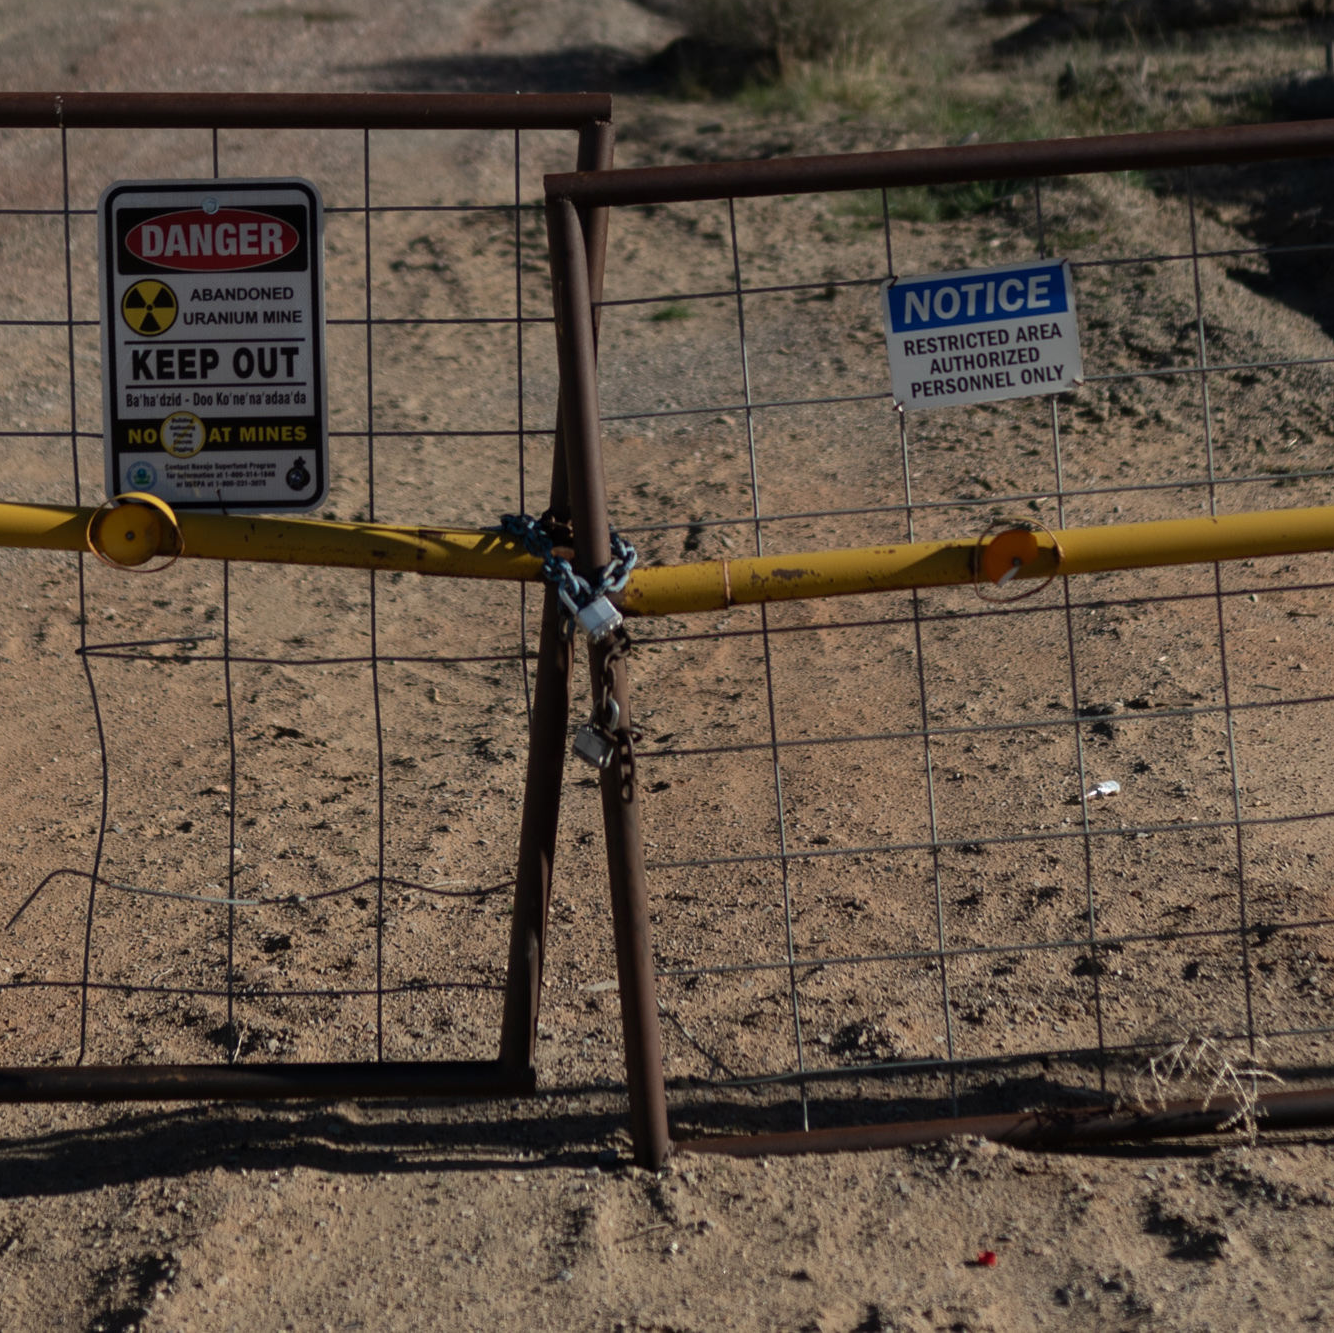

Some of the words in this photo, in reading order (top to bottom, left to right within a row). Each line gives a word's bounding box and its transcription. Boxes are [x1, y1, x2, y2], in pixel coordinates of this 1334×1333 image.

[141, 222, 285, 257] DANGER
[190, 287, 294, 301] ABANDONED
[904, 274, 1052, 324] NOTICE
[183, 311, 258, 325] URANIUM
[262, 310, 303, 324] MINE
[903, 328, 1010, 356] RESTRICTED
[1015, 322, 1063, 343] AREA
[132, 347, 220, 381] KEEP
[232, 346, 300, 379] OUT
[929, 346, 1040, 375] AUTHORIZED
[910, 371, 1016, 398] PERSONNEL
[1020, 364, 1065, 385] ONLY
[193, 392, 214, 407] Doo
[128, 428, 158, 444] NO
[208, 427, 233, 443] AT
[239, 425, 308, 443] MINES
[165, 463, 190, 471] Contact
[191, 463, 213, 471] Navajo
[215, 462, 247, 470] Superfund
[249, 462, 276, 470] Program
[216, 471, 223, 479] at
[207, 480, 214, 488] at
